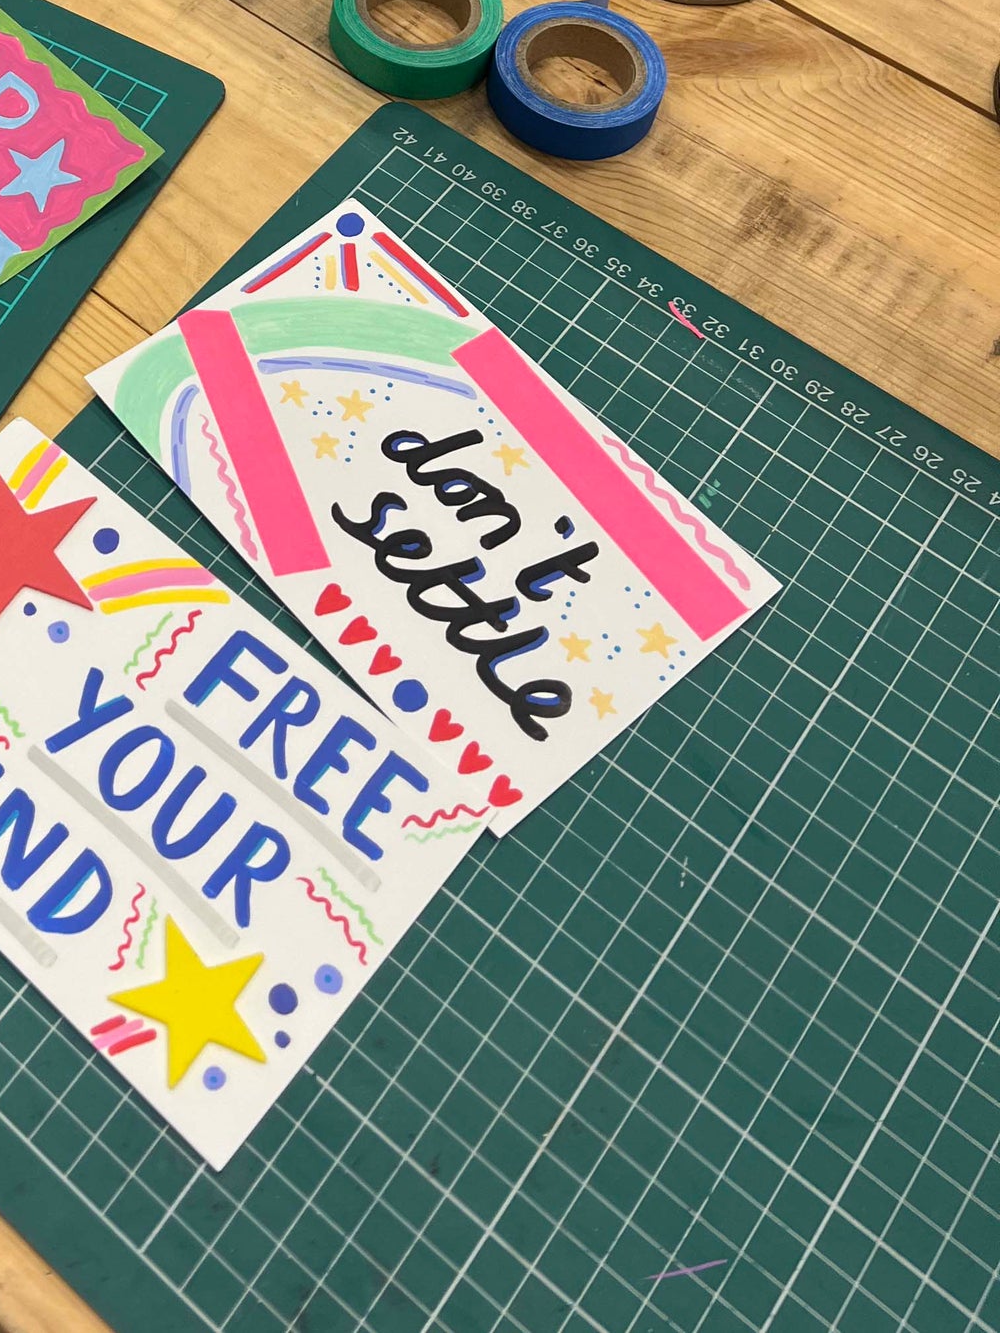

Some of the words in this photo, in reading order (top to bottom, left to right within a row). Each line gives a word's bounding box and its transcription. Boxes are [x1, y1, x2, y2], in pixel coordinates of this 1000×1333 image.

[392, 126, 418, 146] 42
[422, 146, 448, 164] 41
[452, 163, 477, 182] 40
[481, 181, 507, 202] 39
[511, 200, 538, 221] 38
[541, 219, 569, 240] 37
[572, 237, 600, 258] 36
[603, 256, 632, 278] 35
[638, 276, 664, 298] 34
[702, 315, 731, 339] 32
[737, 338, 765, 361] 31
[770, 358, 799, 381] 30
[804, 379, 835, 403] 29
[840, 401, 871, 425] 28
[874, 425, 908, 448] 27
[912, 445, 945, 470] 26
[949, 468, 983, 494] 25
[381, 429, 599, 602] don't
[331, 492, 573, 742] settle
[182, 629, 430, 861] FREE
[44, 666, 292, 928] YOUR
